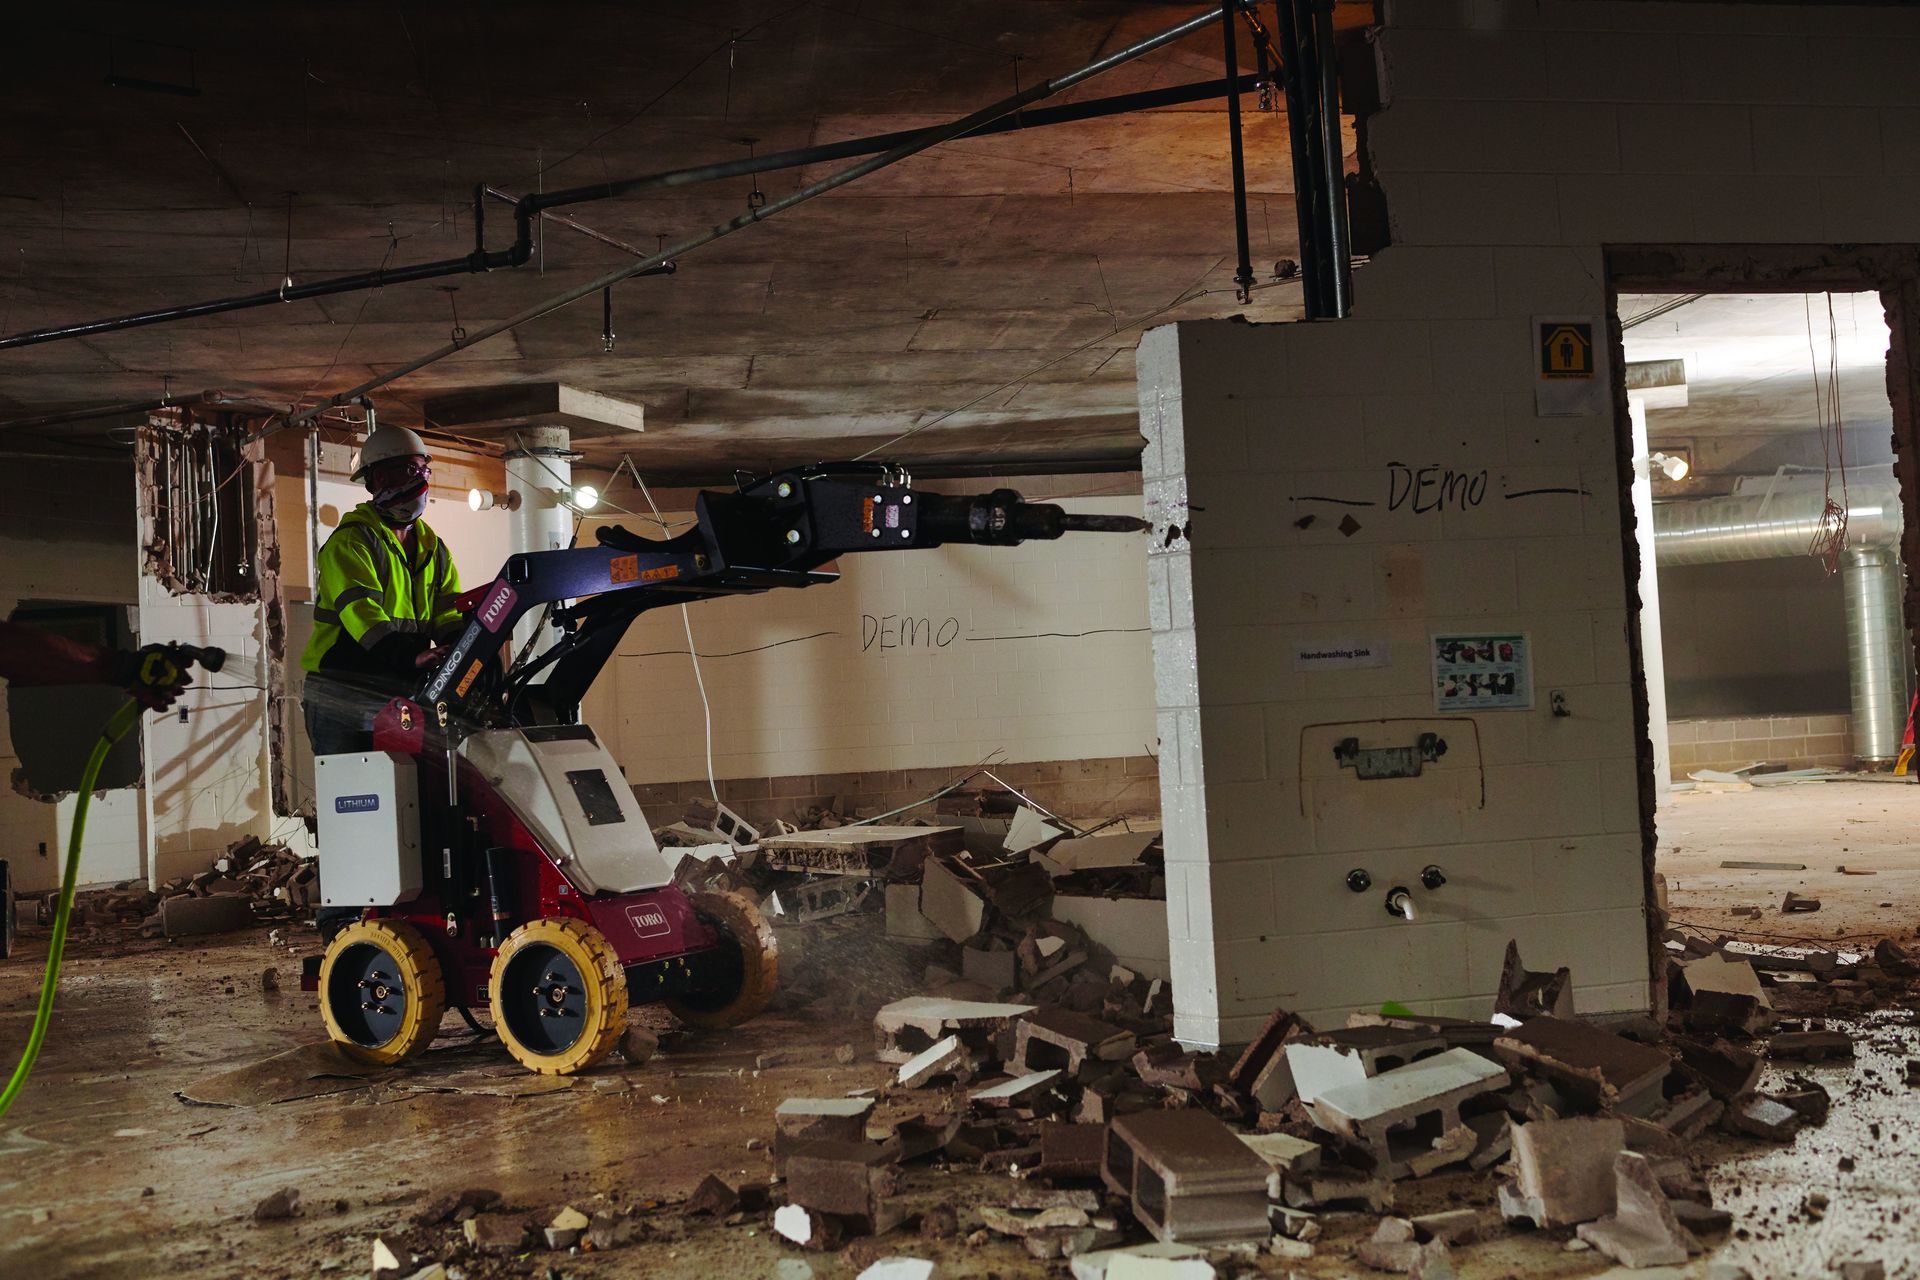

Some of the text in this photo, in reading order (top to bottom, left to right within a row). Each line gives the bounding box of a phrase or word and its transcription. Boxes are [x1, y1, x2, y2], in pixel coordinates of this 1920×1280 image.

[1387, 462, 1487, 514] DEMO
[483, 587, 511, 624] TORO
[461, 625, 479, 650] 500
[862, 614, 959, 652] DEMO
[1300, 648, 1371, 660] Handwashing Sink
[338, 798, 376, 809] LITHIUM
[632, 912, 663, 928] TORO
